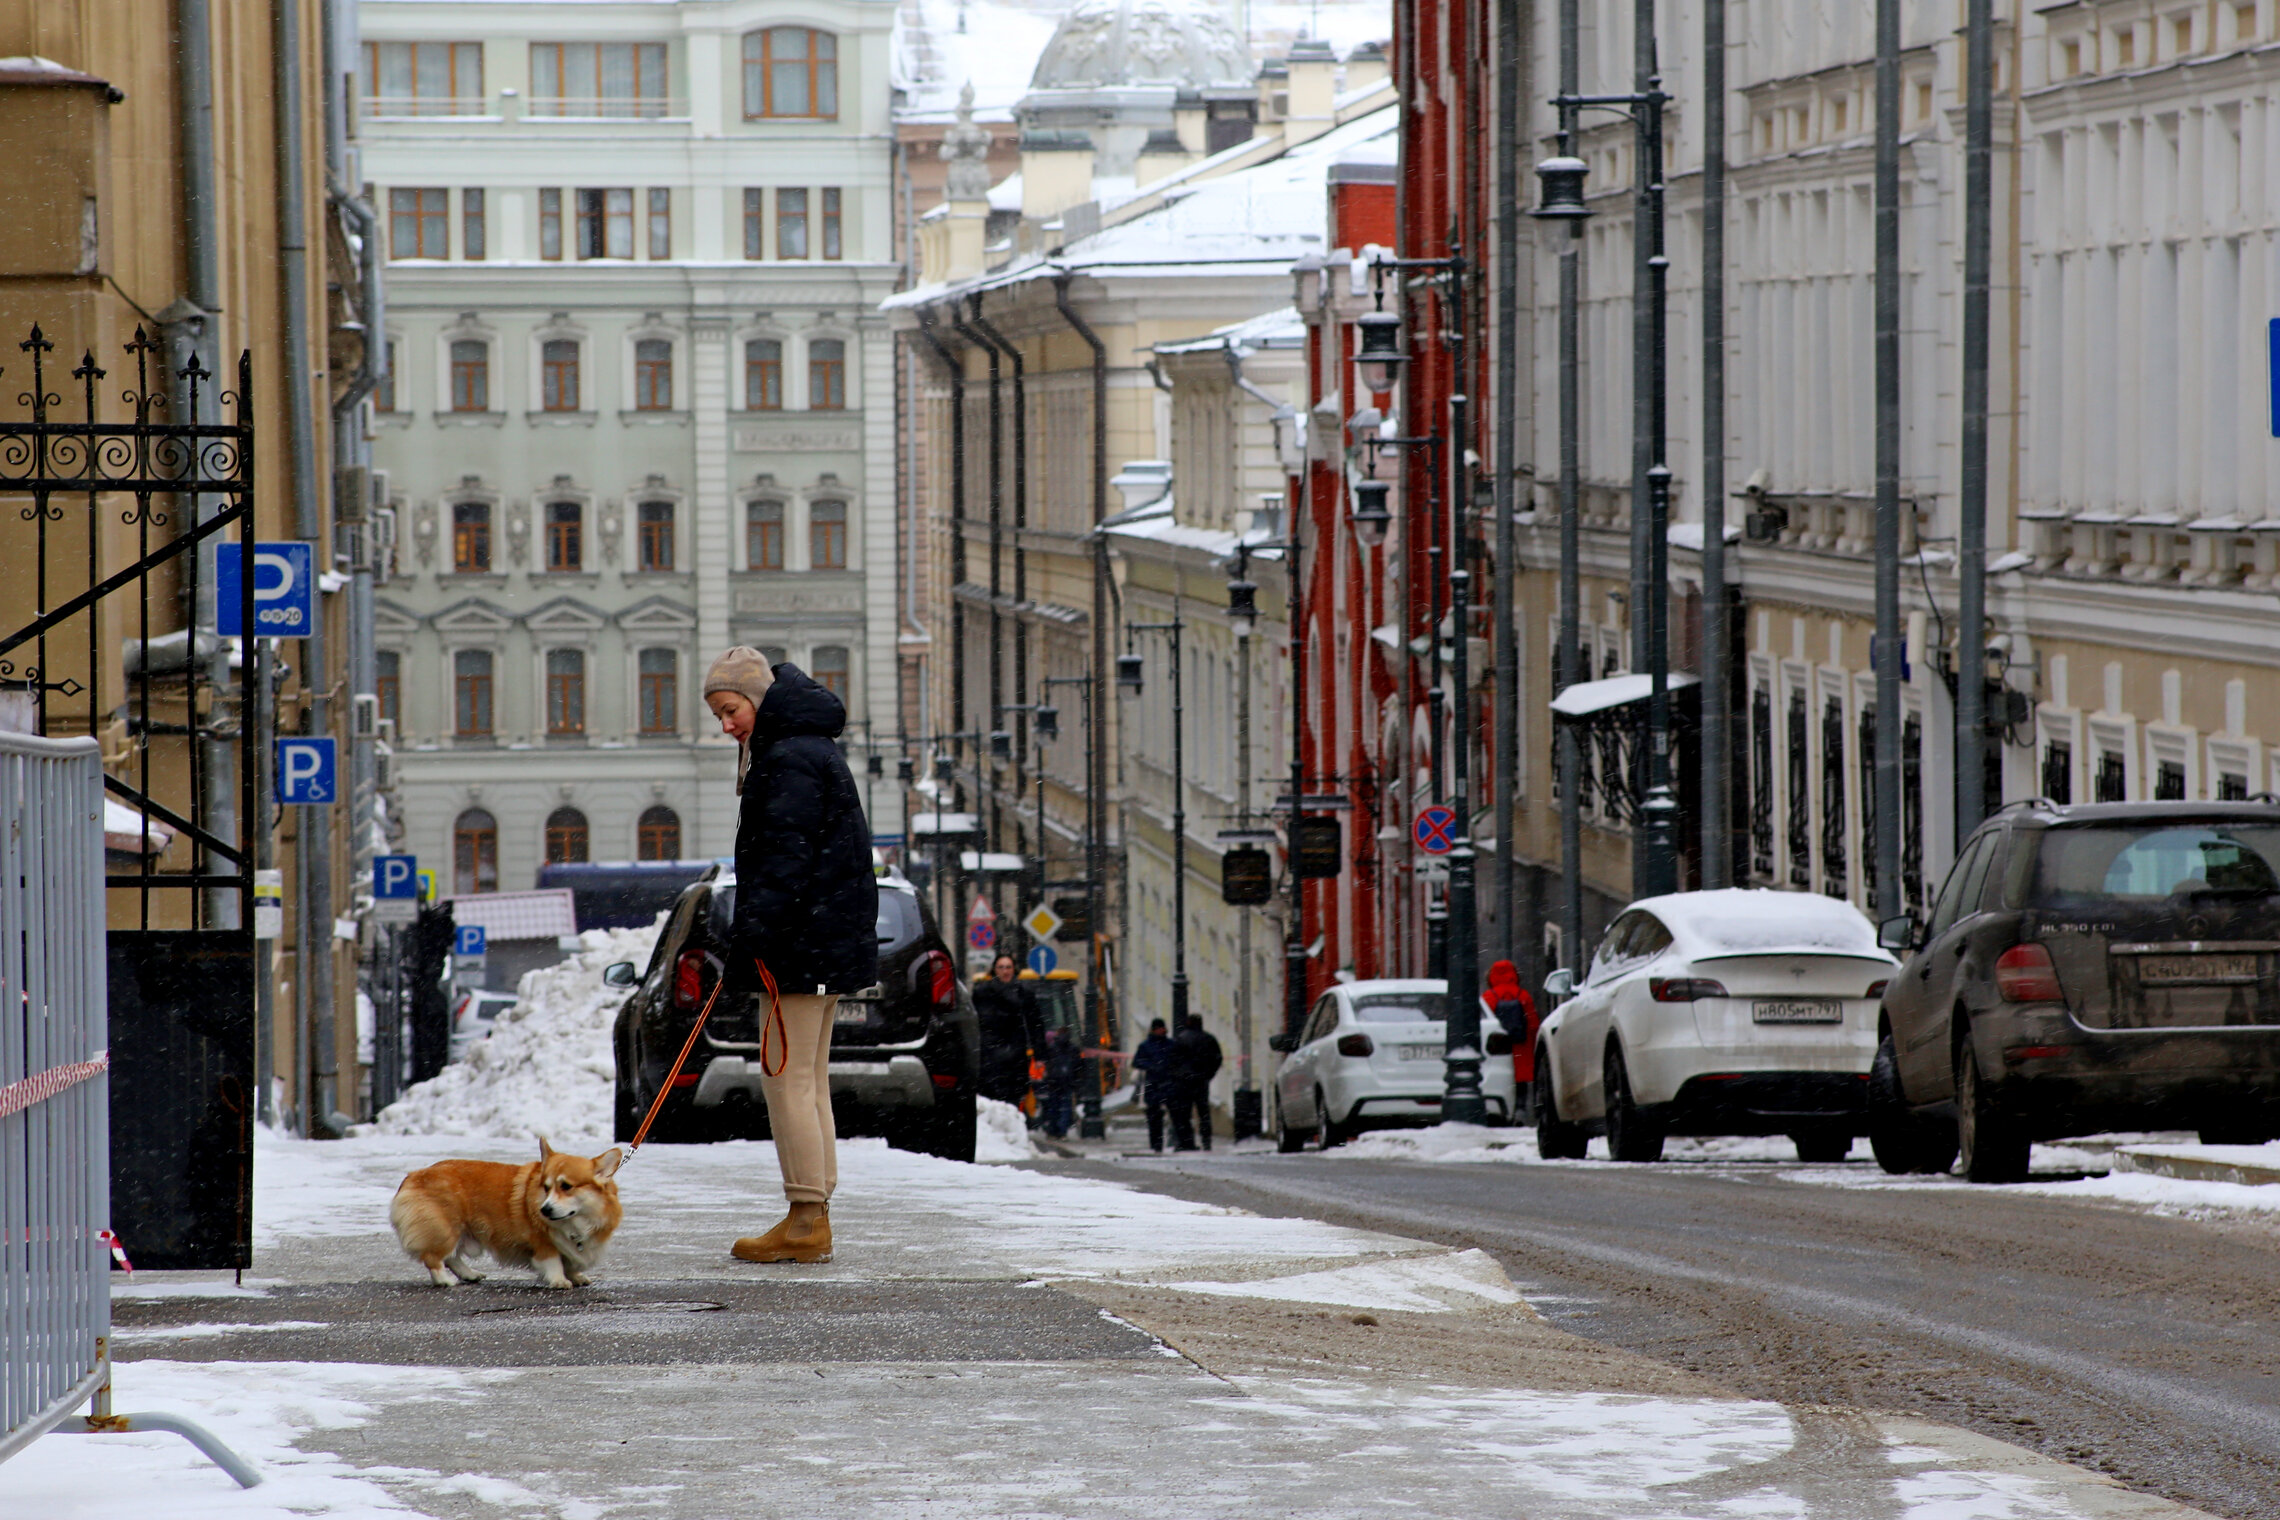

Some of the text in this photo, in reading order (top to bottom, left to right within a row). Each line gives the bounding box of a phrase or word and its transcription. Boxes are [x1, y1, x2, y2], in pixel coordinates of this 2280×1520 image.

[286, 610, 301, 621] 20
[285, 745, 321, 797] P
[385, 859, 409, 895] P
[462, 928, 482, 953] P
[838, 1003, 862, 1016] 799
